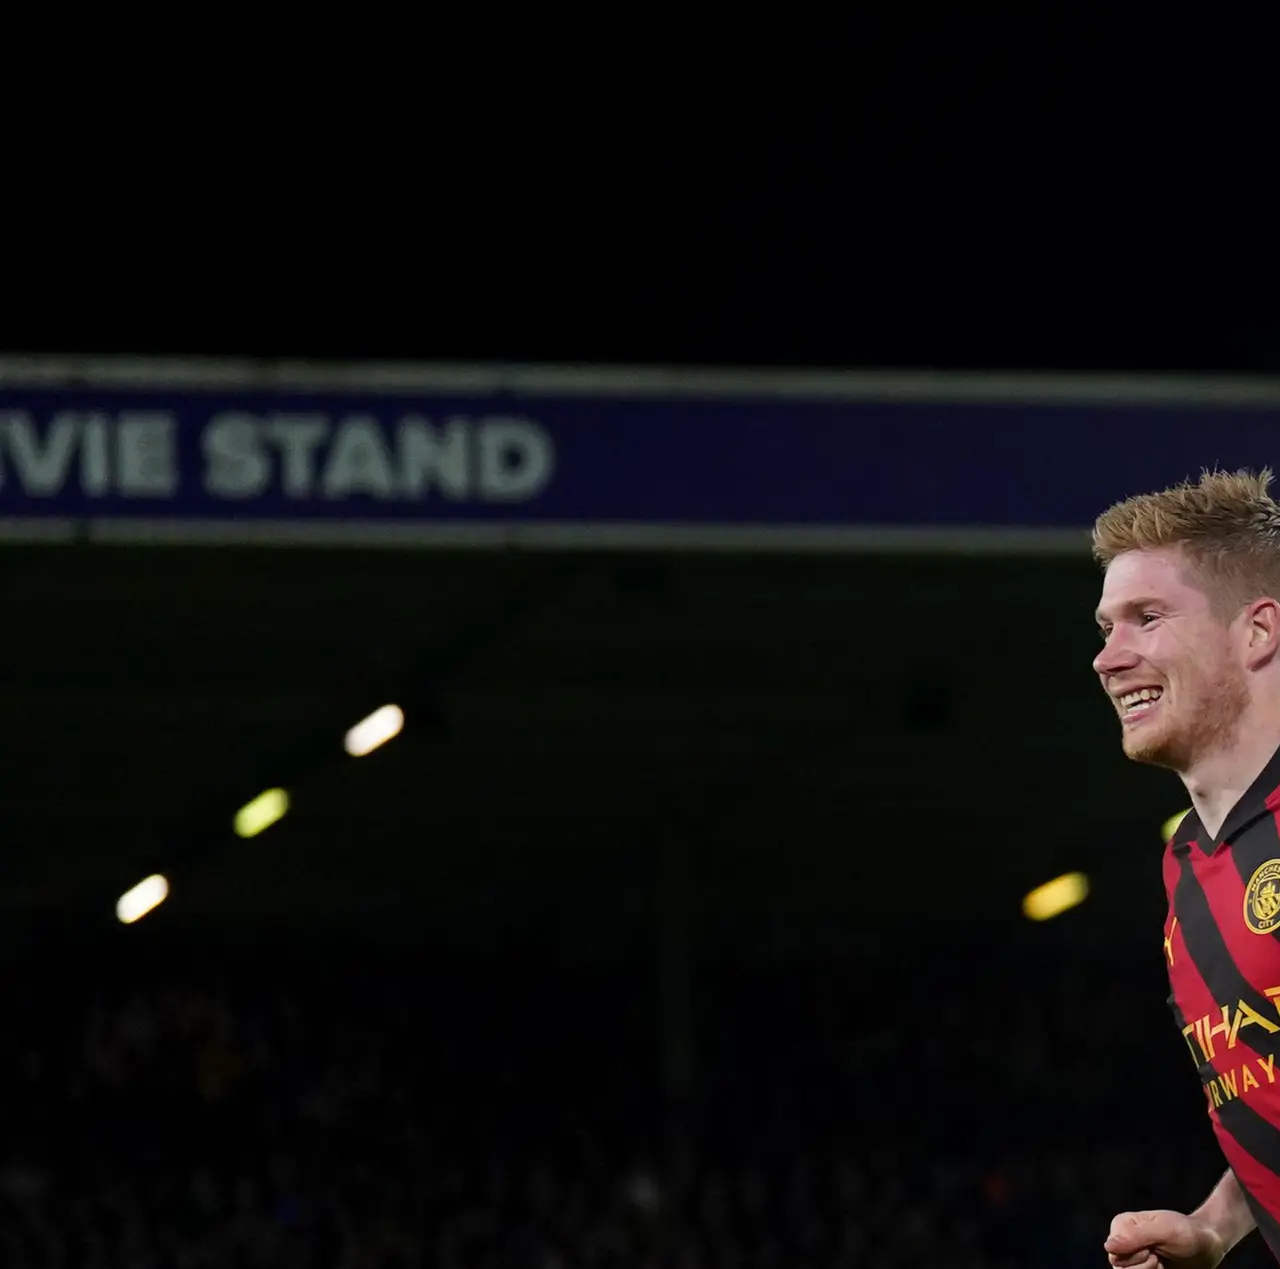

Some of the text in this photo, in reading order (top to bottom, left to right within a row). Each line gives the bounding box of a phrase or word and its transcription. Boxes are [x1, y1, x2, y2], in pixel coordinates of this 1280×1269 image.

[0, 411, 554, 499] VIE STAND
[1258, 918, 1276, 930] CITY
